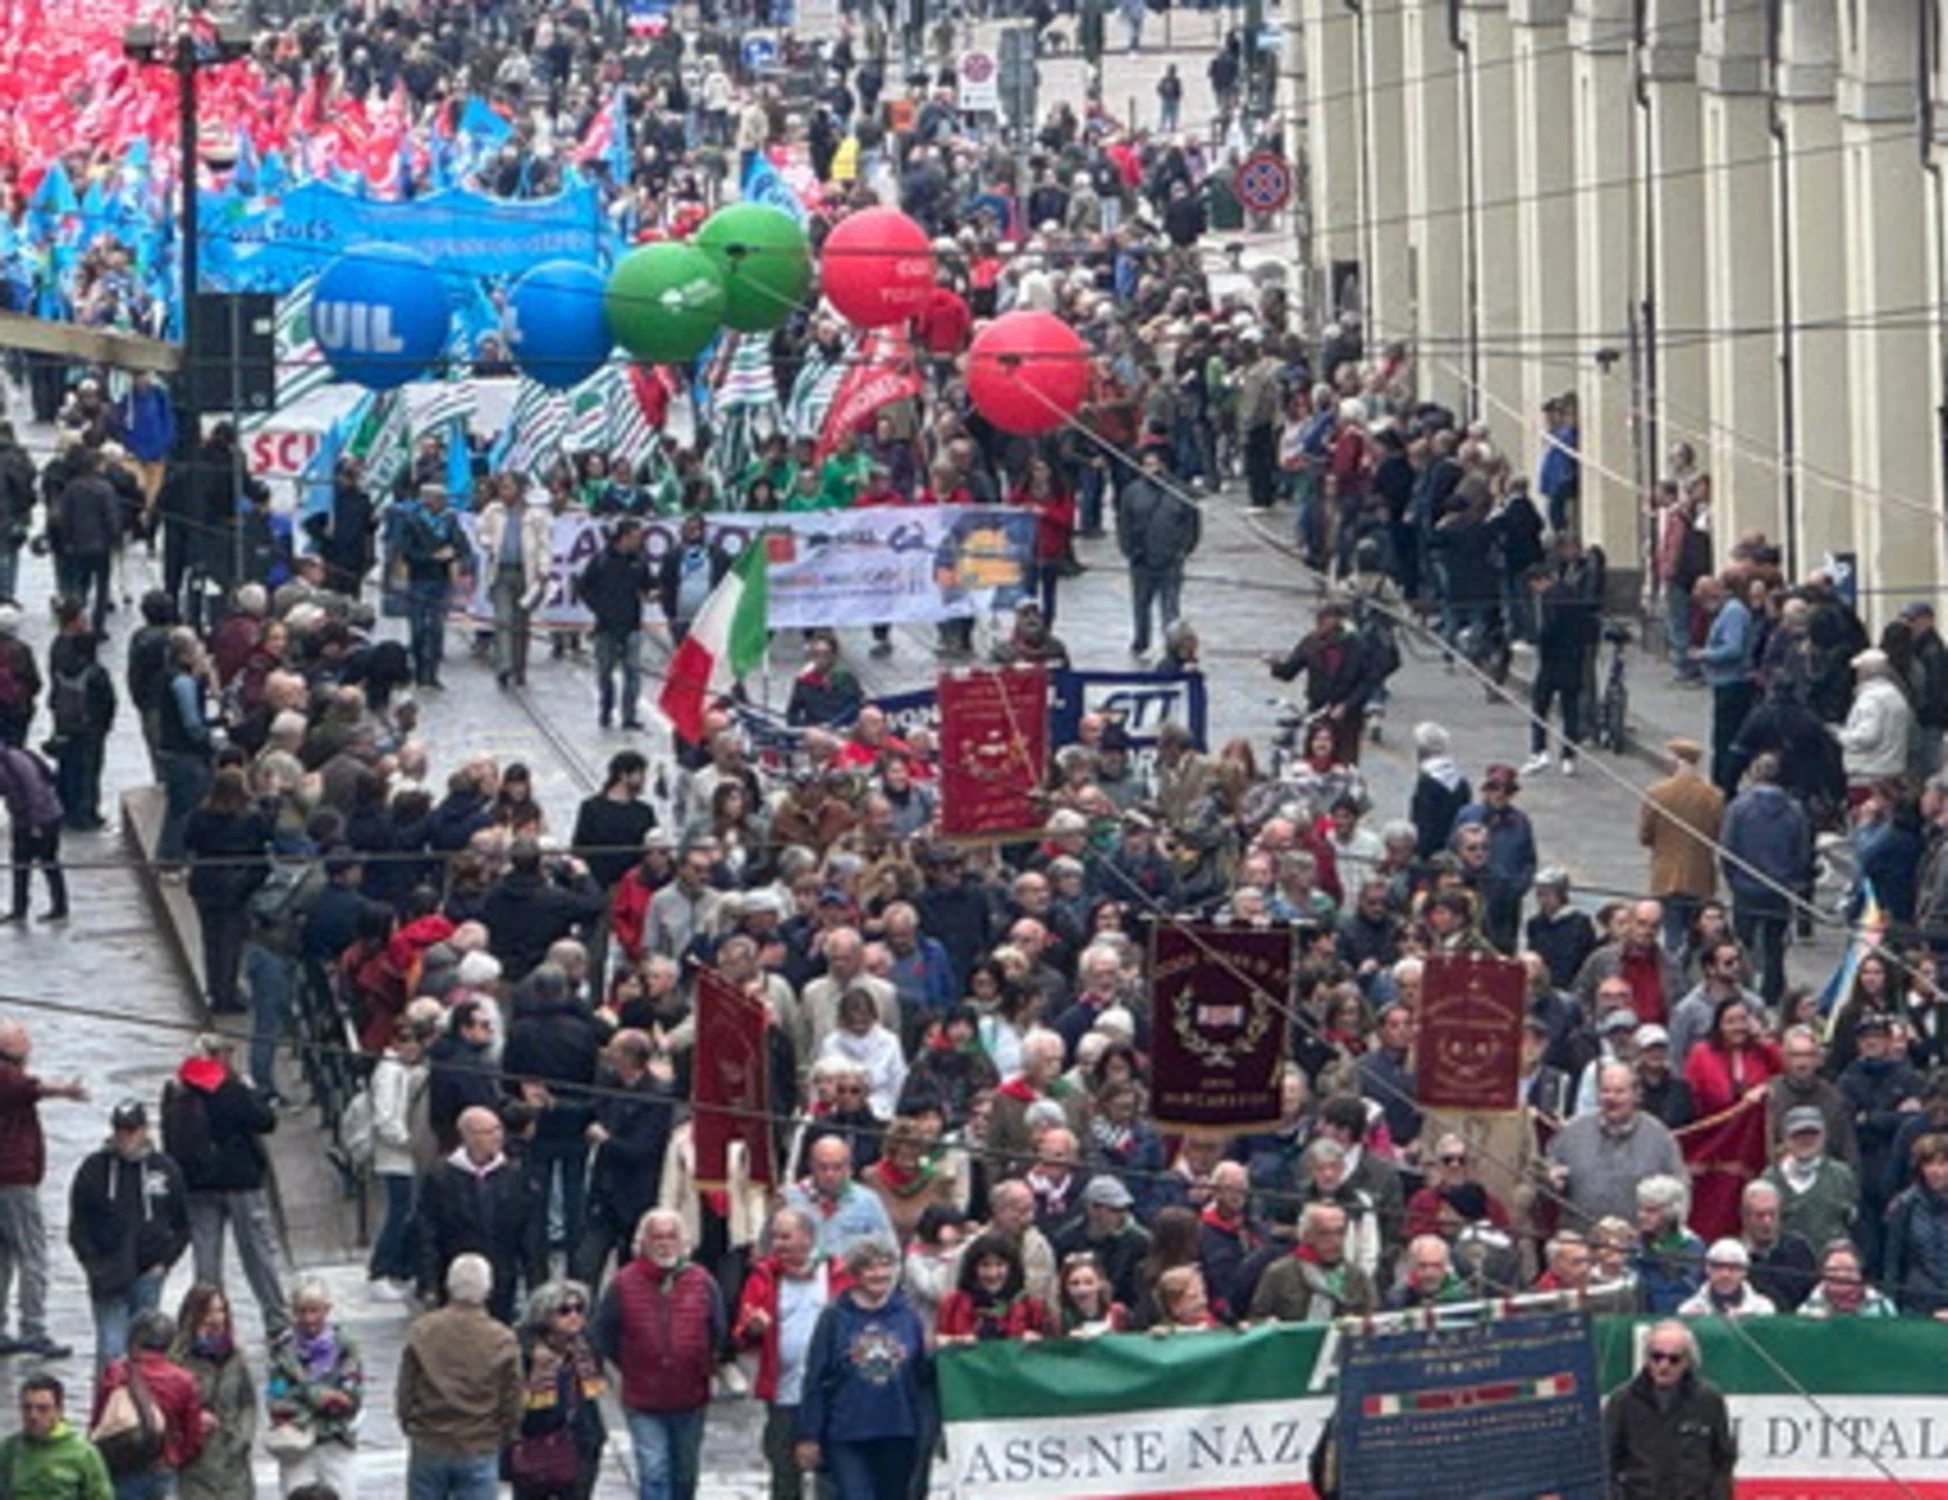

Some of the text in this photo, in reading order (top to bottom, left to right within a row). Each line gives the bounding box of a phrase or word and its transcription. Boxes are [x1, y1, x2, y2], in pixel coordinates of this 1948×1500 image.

[316, 302, 404, 353] UIL
[963, 1430, 1167, 1485] ASS.NE
[1188, 1420, 1301, 1469] NAZ
